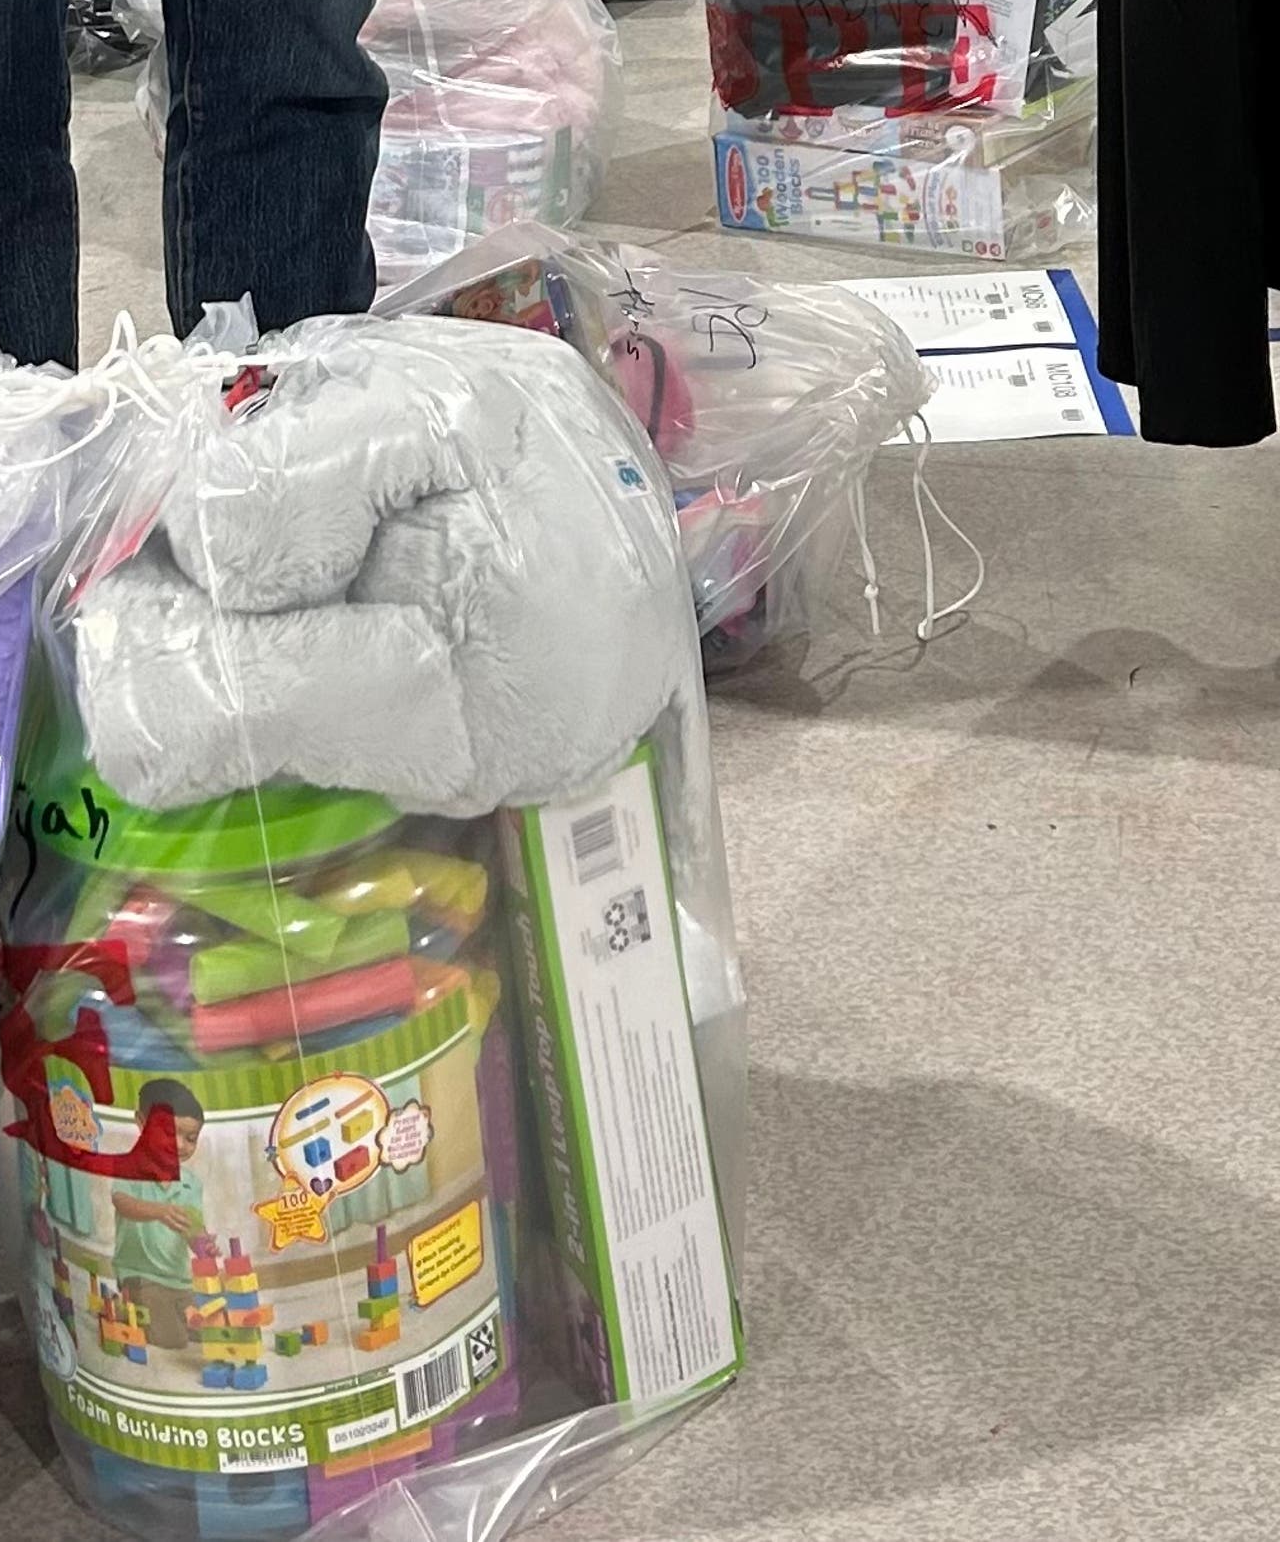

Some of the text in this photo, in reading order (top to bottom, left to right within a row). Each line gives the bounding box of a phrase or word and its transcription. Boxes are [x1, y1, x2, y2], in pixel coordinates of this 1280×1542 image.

[280, 1192, 309, 1211] 100
[66, 1382, 111, 1426] Foam
[116, 1410, 209, 1448] Building
